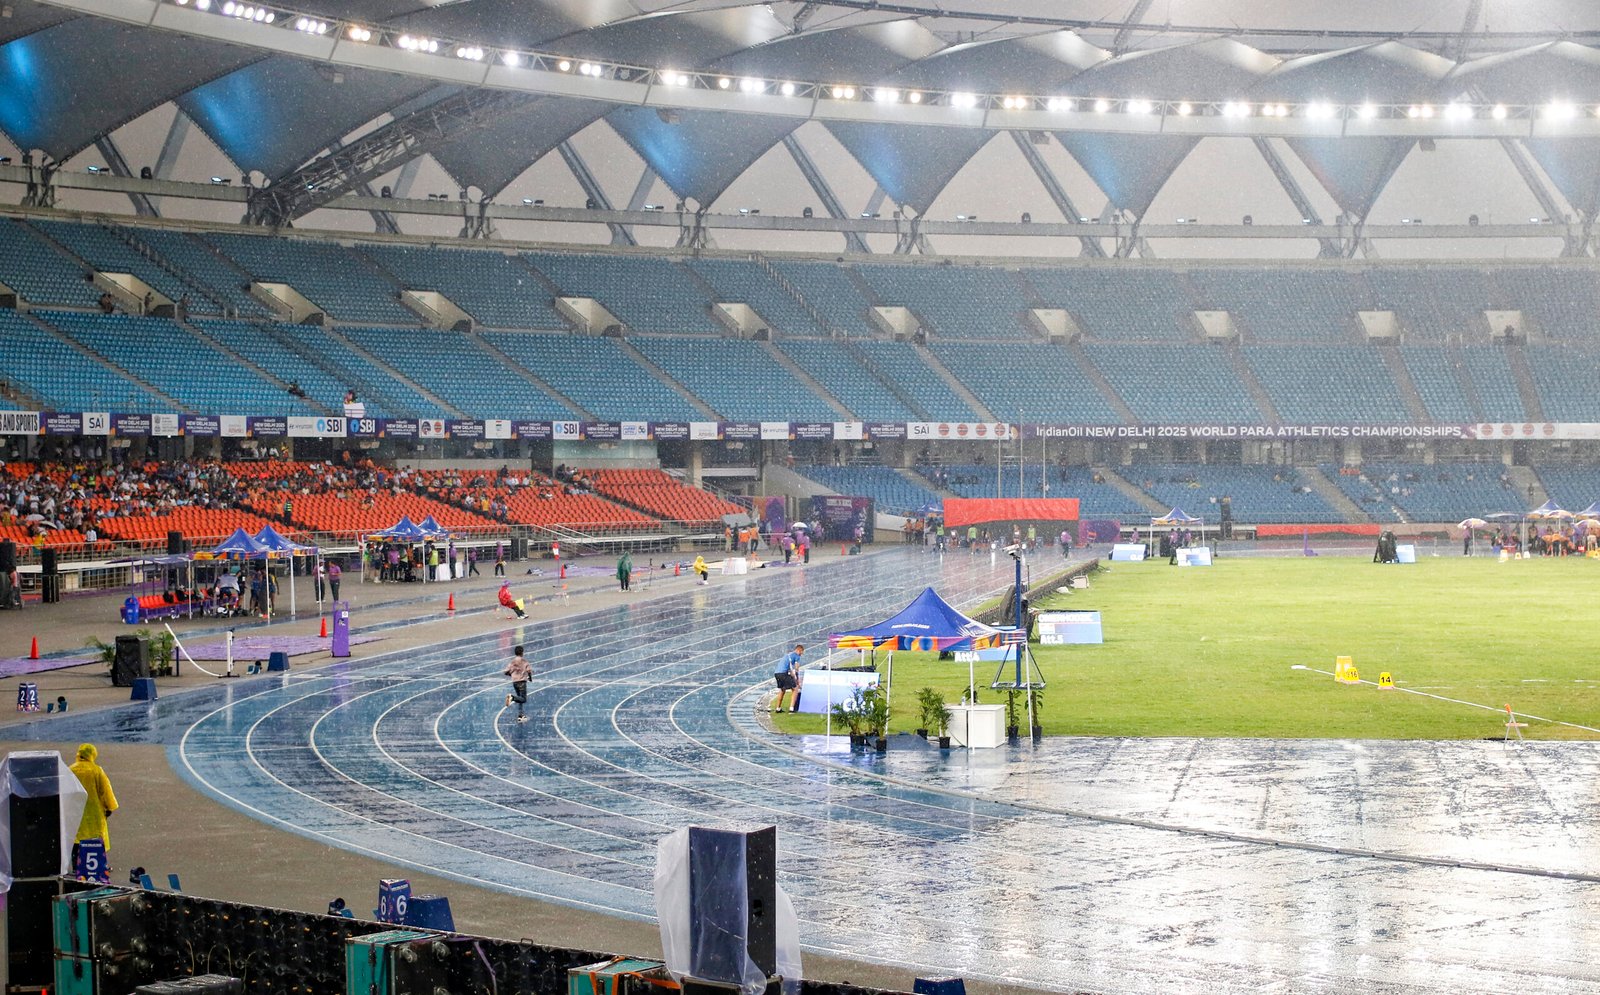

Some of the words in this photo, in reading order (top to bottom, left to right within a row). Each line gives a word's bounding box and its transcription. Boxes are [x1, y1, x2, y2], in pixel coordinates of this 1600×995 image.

[3, 414, 15, 431] AND
[16, 414, 38, 431] SPORTS
[89, 417, 104, 428] SAI
[327, 419, 342, 432] SBI
[360, 420, 375, 433] SBI
[563, 424, 577, 434] SBI
[914, 425, 929, 434] SAI
[1086, 426, 1116, 436] NEW
[1118, 426, 1155, 436] DELHI
[1158, 426, 1187, 436] 2025
[1190, 426, 1237, 436] WORLD
[1240, 426, 1274, 436] PARA
[1277, 426, 1349, 436] ATHLETICS
[1352, 426, 1461, 436] CHAMPIONSHIPS
[21, 690, 25, 701] 2
[30, 690, 36, 701] 2
[86, 852, 98, 870] 5
[381, 896, 386, 915] 6
[397, 894, 407, 915] 6
